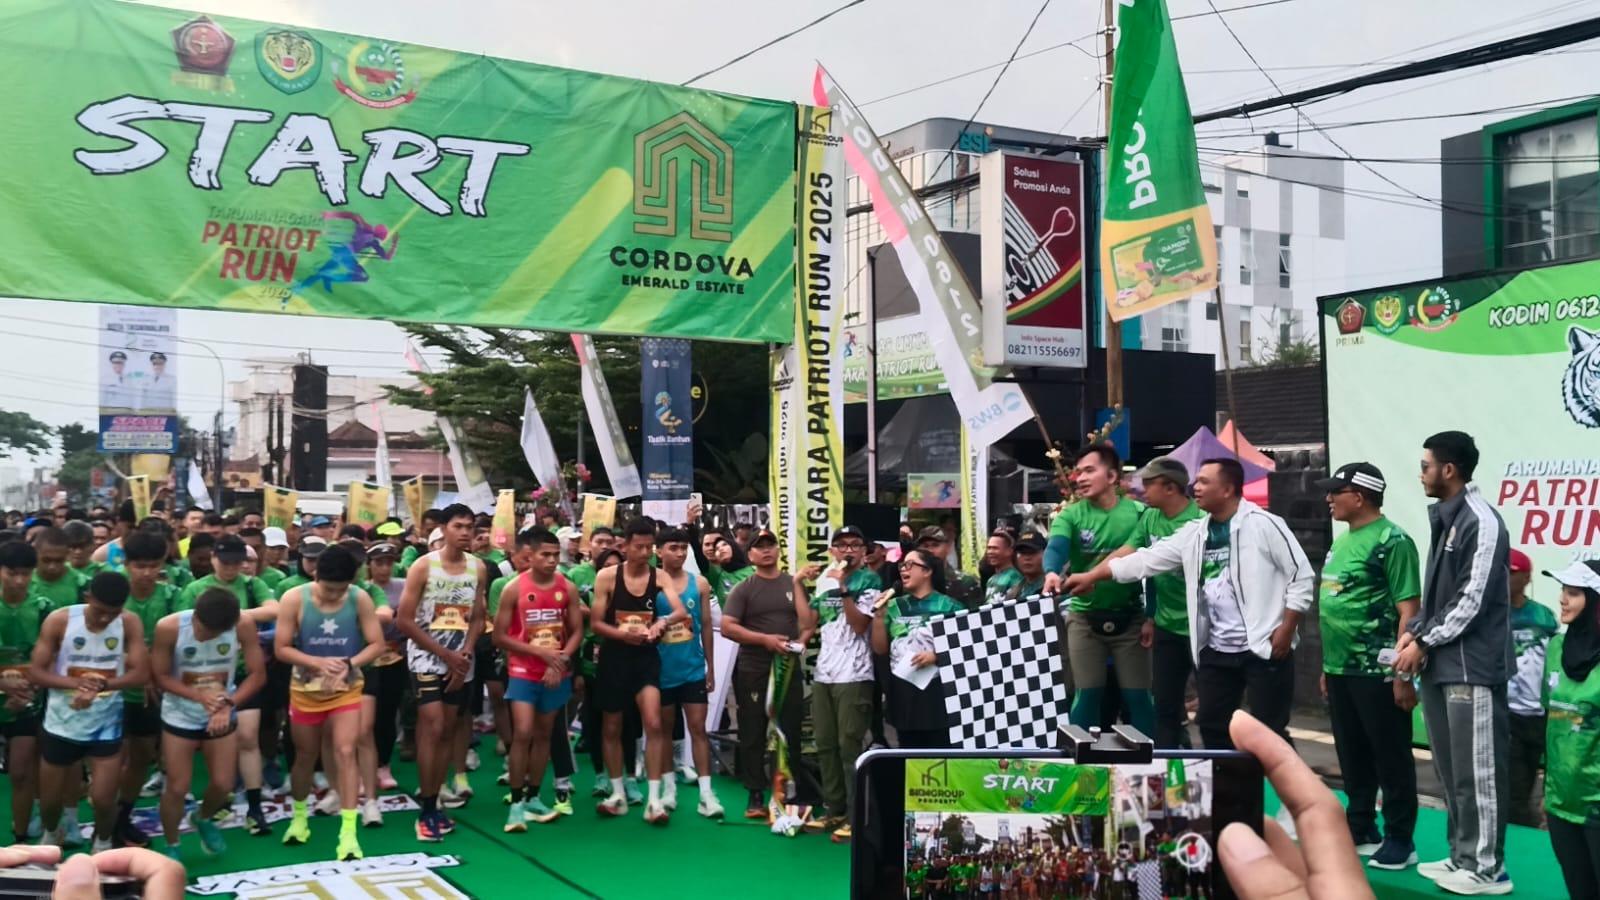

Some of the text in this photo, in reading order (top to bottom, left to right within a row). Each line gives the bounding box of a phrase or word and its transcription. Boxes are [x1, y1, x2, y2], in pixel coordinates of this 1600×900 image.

[74, 94, 532, 217] START
[1013, 166, 1040, 179] Solusi
[1013, 180, 1072, 195] Promosi Anda
[809, 172, 833, 243] 2025
[203, 221, 321, 252] PATRIOT
[219, 248, 298, 283] RUN
[609, 246, 754, 278] CORDOVA
[622, 274, 745, 294] EMERALD ESTATE
[808, 254, 831, 311] RUN
[1489, 295, 1600, 328] KODIM 0612
[1008, 343, 1081, 358] 082115556697
[807, 320, 830, 434] PATRIOT
[778, 486, 789, 548] PATRIOT
[984, 774, 1059, 793] START
